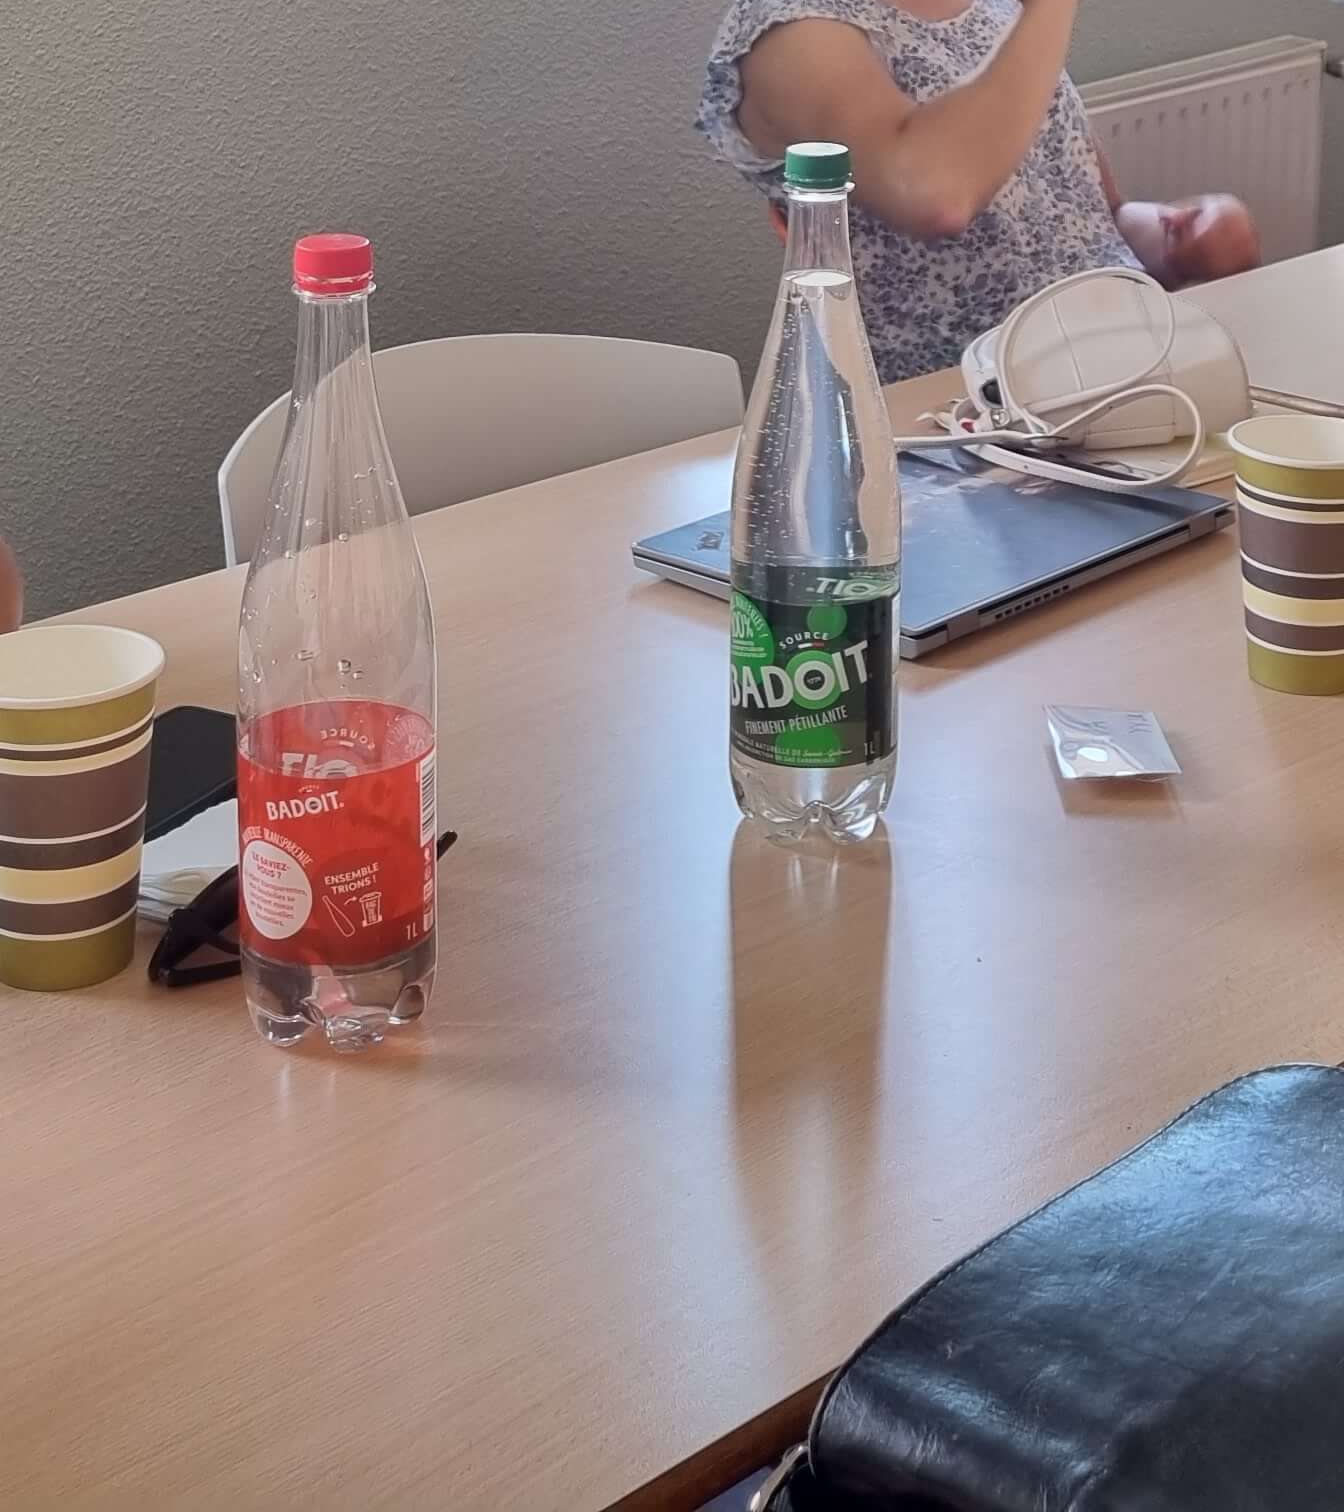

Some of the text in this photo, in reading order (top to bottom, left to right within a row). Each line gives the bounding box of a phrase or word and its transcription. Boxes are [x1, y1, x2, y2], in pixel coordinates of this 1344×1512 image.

[778, 631, 830, 649] SOURCE
[788, 705, 849, 732] PÉTILLANTE
[324, 862, 380, 885] ENSEMBLE
